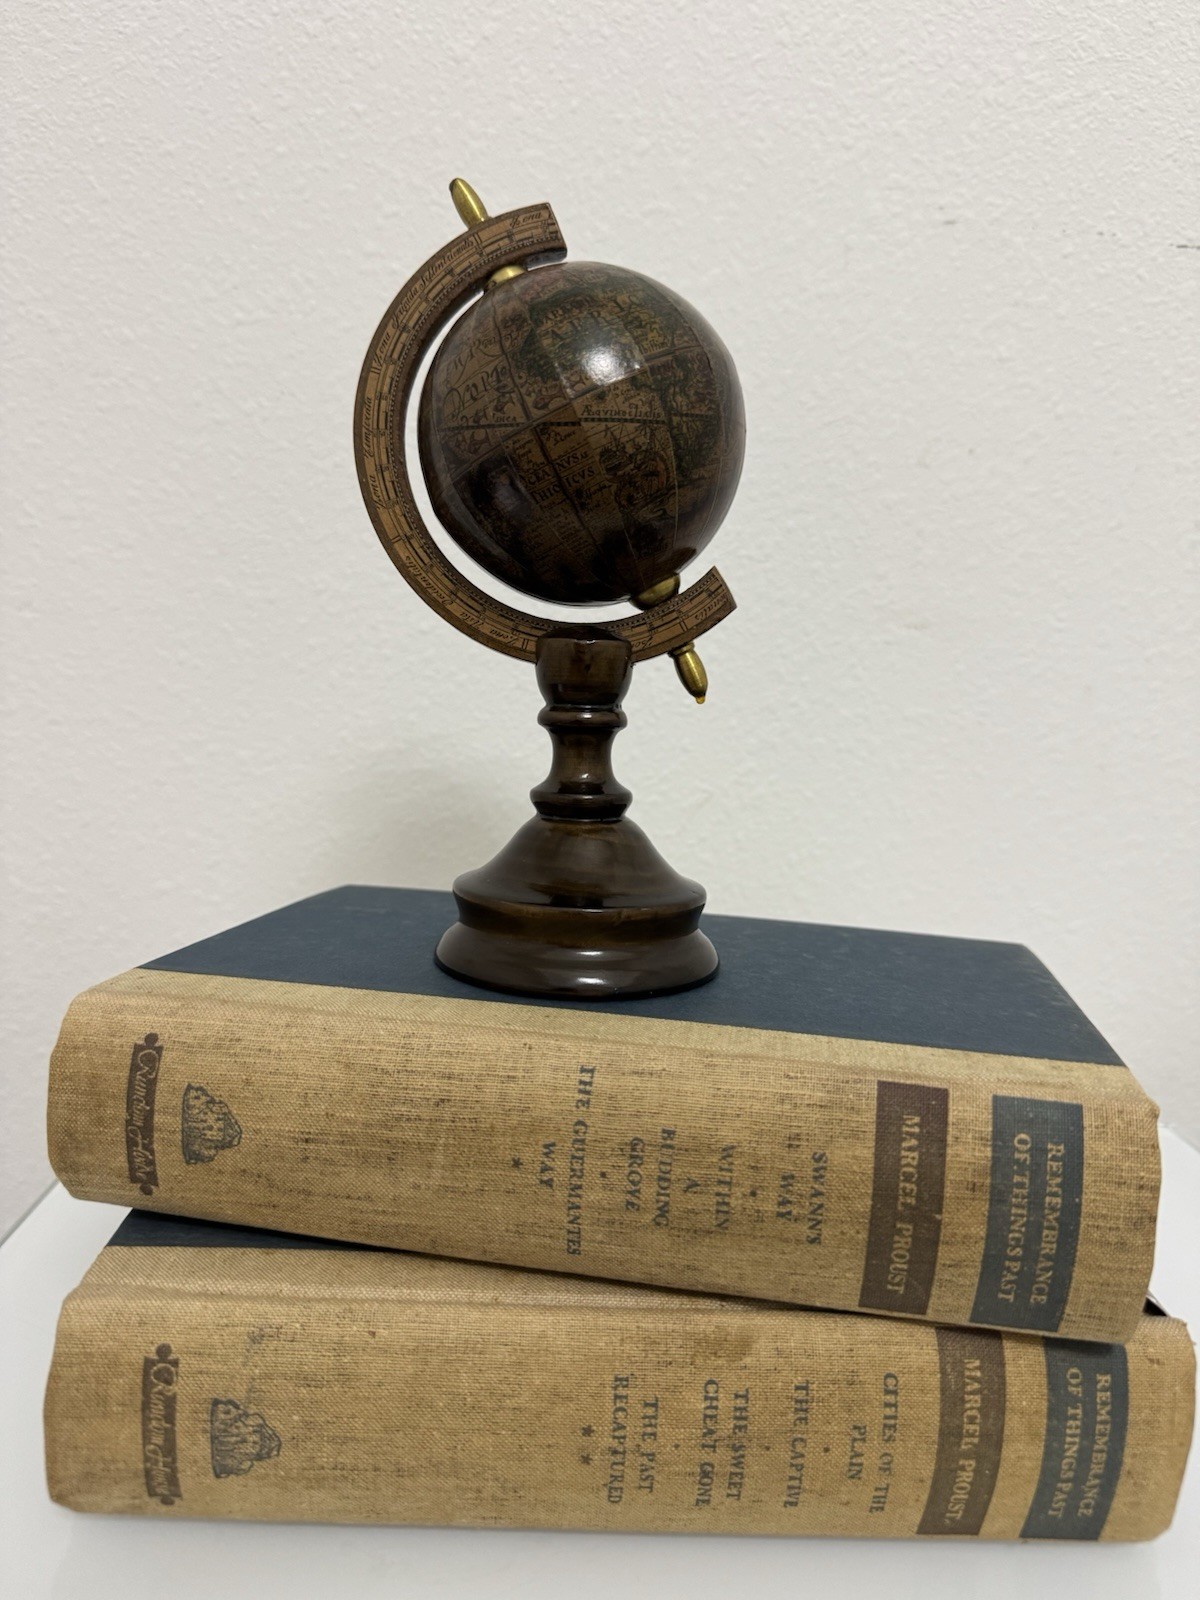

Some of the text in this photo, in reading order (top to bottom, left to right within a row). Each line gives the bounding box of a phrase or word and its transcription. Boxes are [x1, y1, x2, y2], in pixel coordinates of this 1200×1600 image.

[539, 1142, 556, 1190] WAY
[567, 1065, 595, 1256] THE GUERMANTES
[625, 1137, 644, 1212] GROVE
[654, 1128, 676, 1227] BUDDING
[684, 1178, 700, 1193] A
[714, 1145, 736, 1231] WITHIN
[776, 1174, 795, 1222] WAY
[886, 1114, 921, 1294] MARCEL PROUST
[998, 1133, 1031, 1303] OF THINGS PAST
[1029, 1143, 1065, 1304] REMEMBRANCE
[606, 1376, 629, 1504] RECAPTURED
[638, 1398, 658, 1493] THE PAST
[696, 1379, 719, 1507] CHEAT GONE
[726, 1389, 749, 1501] THE SWEET
[783, 1381, 809, 1509] THE CAPTIVE
[847, 1424, 866, 1481] PLAIN
[869, 1372, 898, 1514] CITIES OF THE
[960, 1358, 982, 1450] MARCEL
[1047, 1367, 1083, 1518] OF THINGS PAST
[1078, 1374, 1112, 1517] REMEMBRANCE
